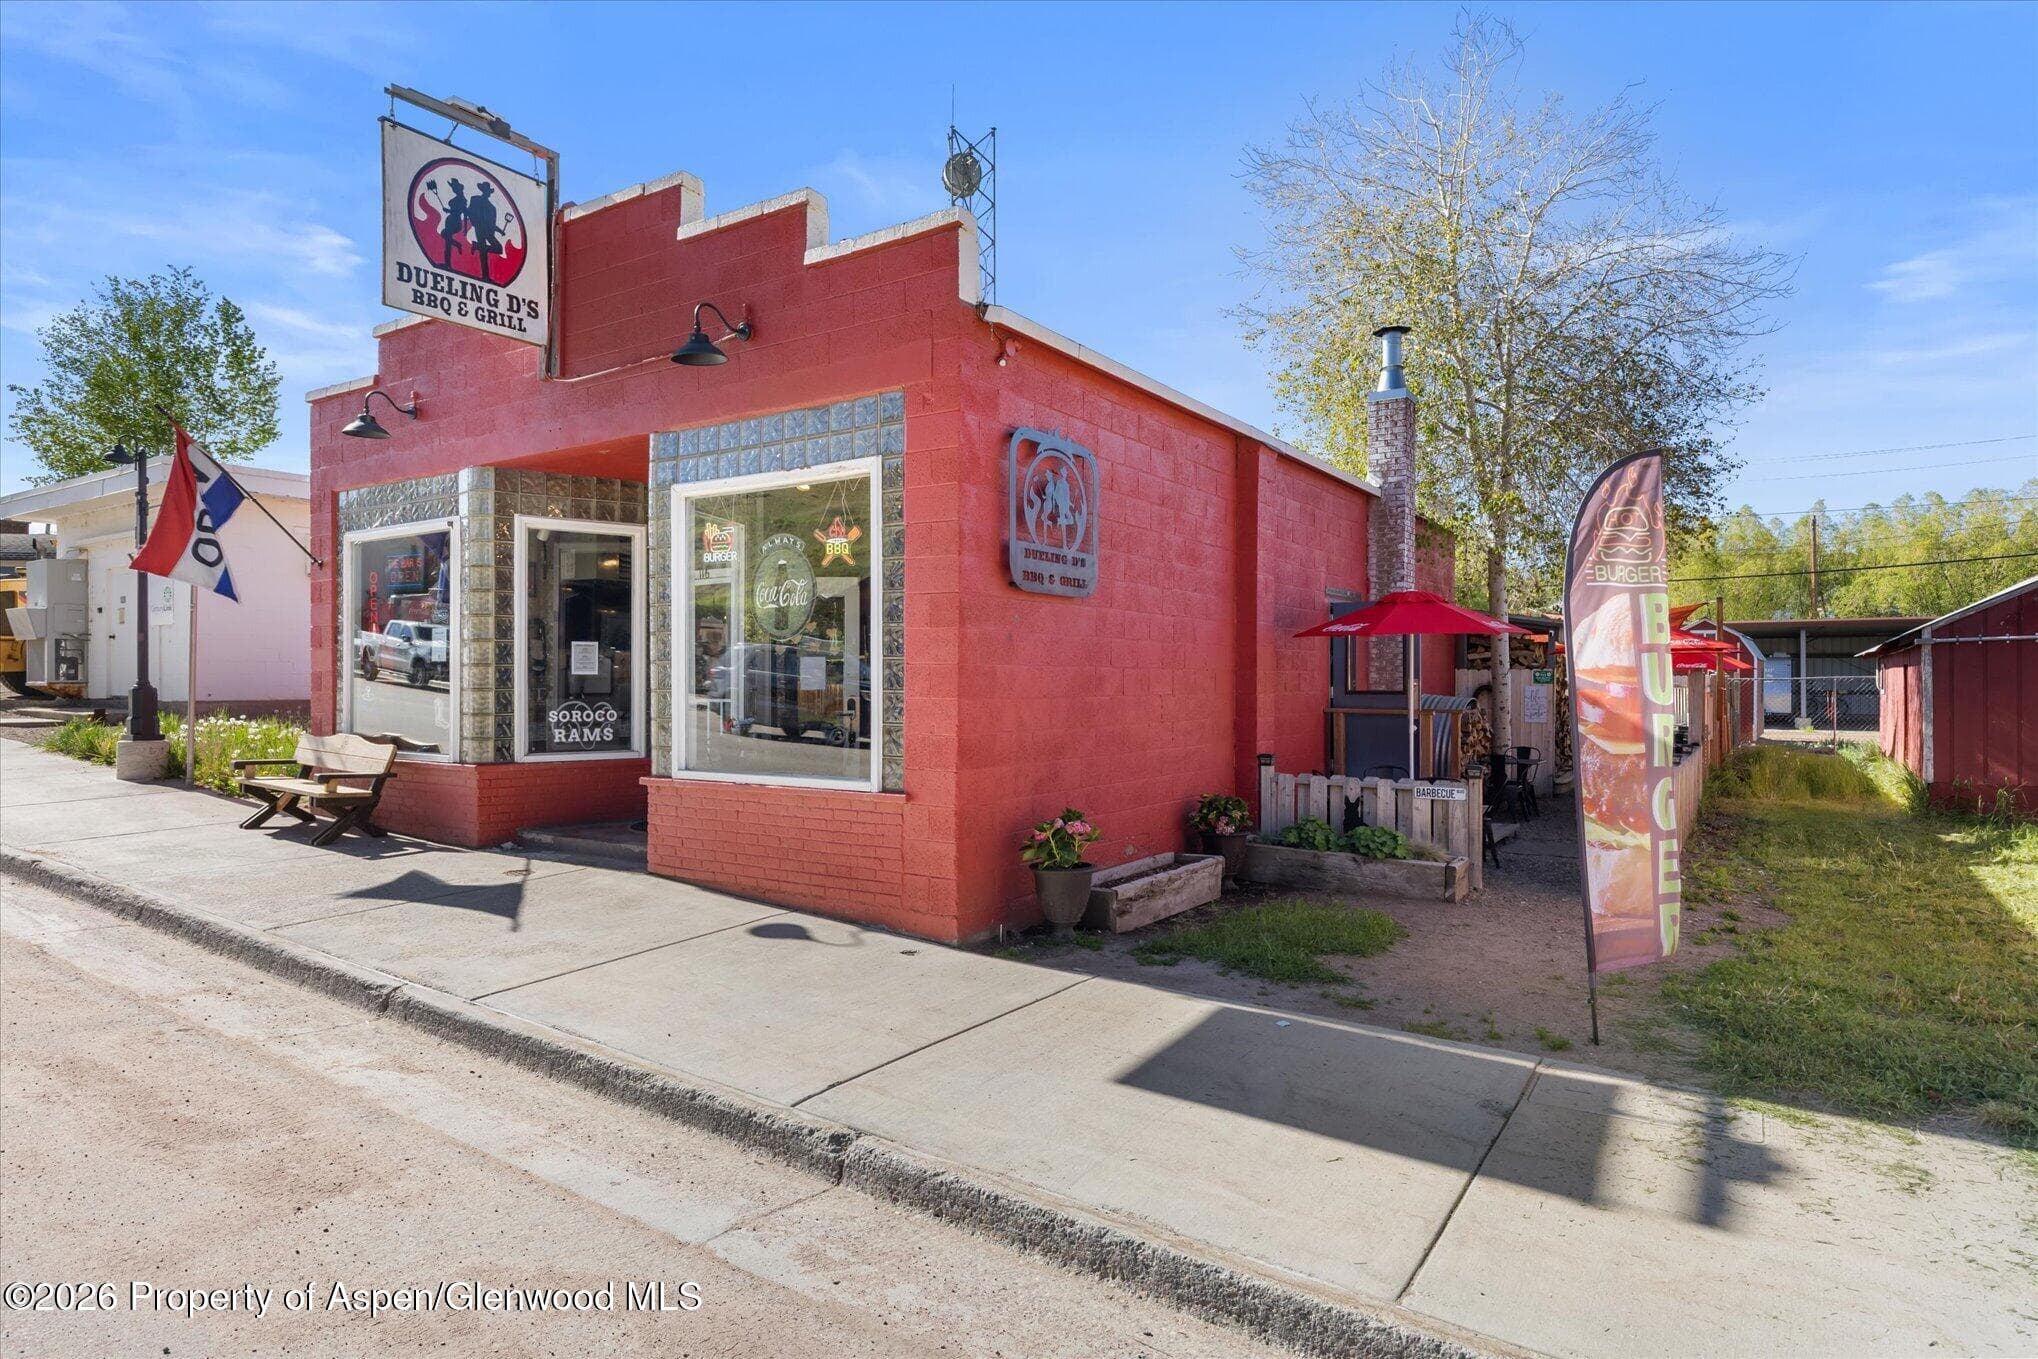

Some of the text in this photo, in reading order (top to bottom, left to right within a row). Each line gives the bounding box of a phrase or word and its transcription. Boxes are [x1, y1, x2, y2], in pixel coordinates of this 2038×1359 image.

[396, 261, 540, 319] DUELING D'S
[411, 288, 527, 333] BBQ & GRILL
[826, 542, 849, 554] BBQ
[703, 551, 738, 563] BURGER
[1024, 548, 1086, 567] DUELING D'S
[1022, 570, 1088, 589] BBQ & GRILL
[1594, 564, 1662, 582] BURGER
[548, 709, 618, 723] SOROCO
[554, 727, 614, 743] RAMS
[1416, 787, 1456, 799] BARBECUE
